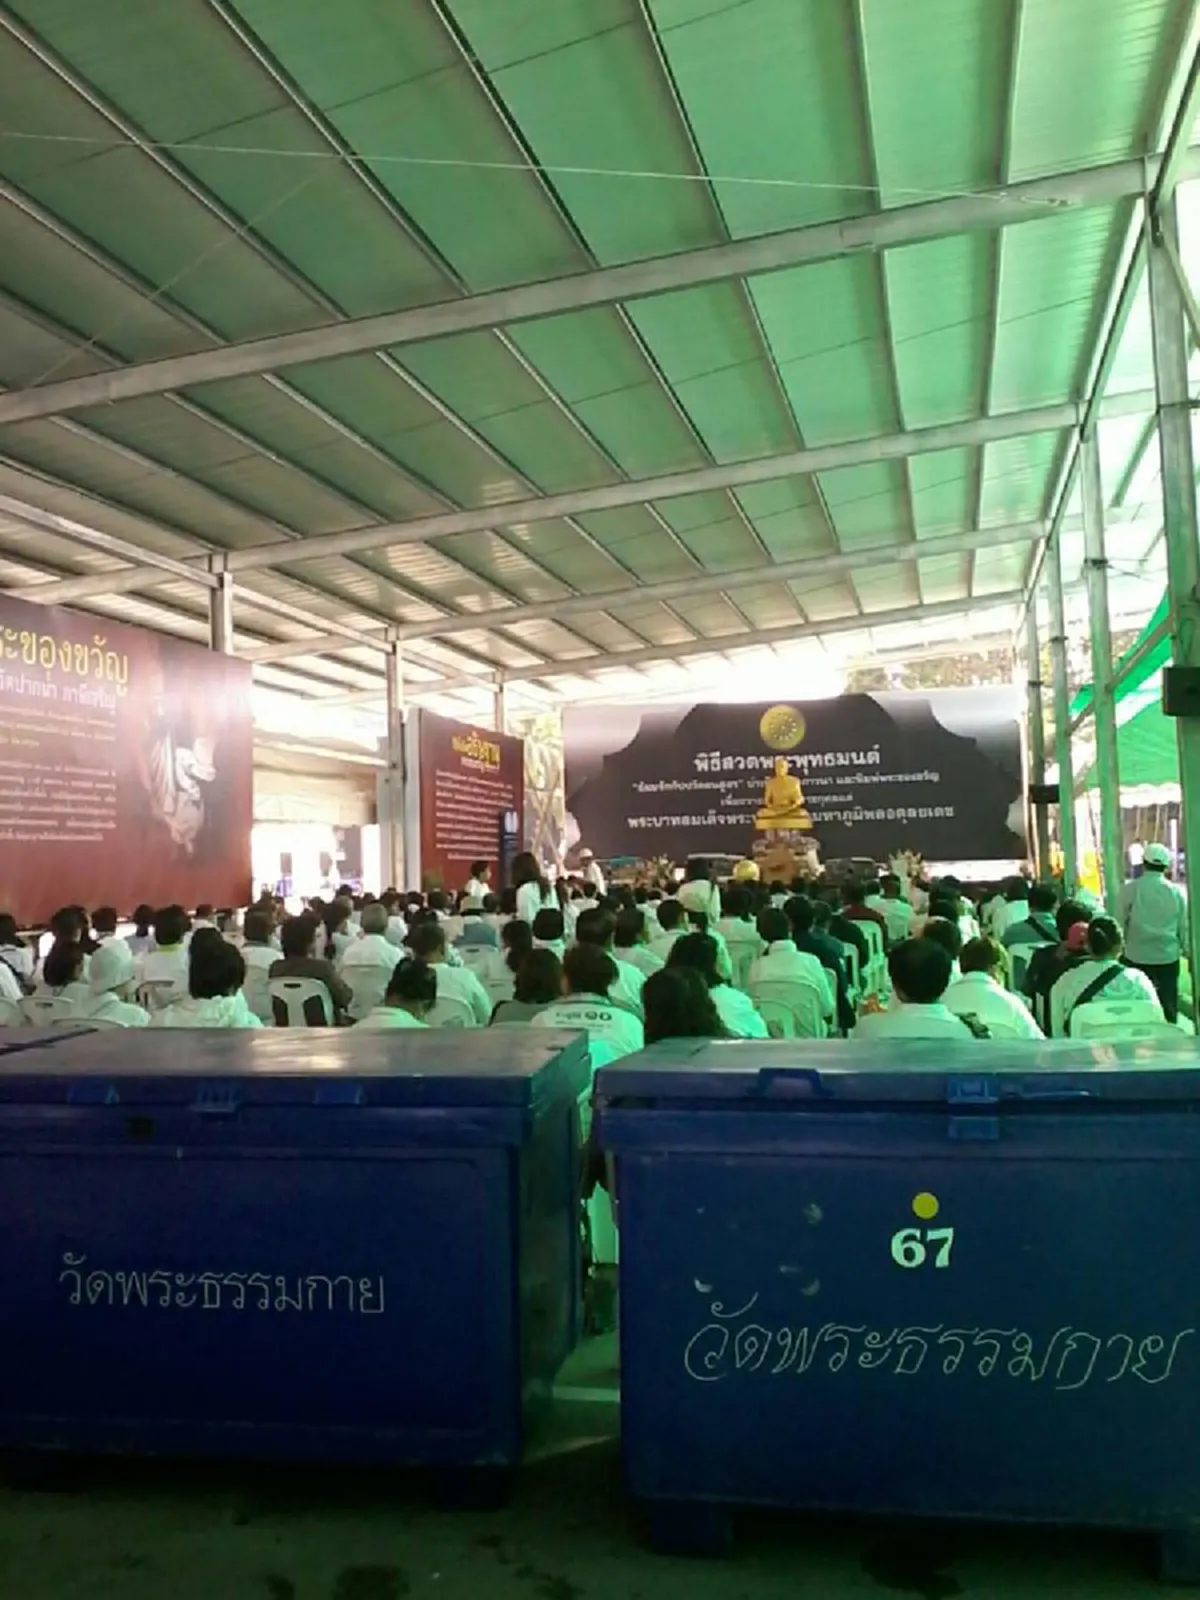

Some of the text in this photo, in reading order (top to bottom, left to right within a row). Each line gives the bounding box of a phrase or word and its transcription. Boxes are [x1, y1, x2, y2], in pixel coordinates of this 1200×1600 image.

[693, 744, 881, 775] พิธีสวดพะพุทธมนต์
[890, 1227, 954, 1268] 67
[58, 1251, 386, 1315] วัดพระธรรมกาย
[684, 1292, 1196, 1391] วัดพระธรรมกาย
